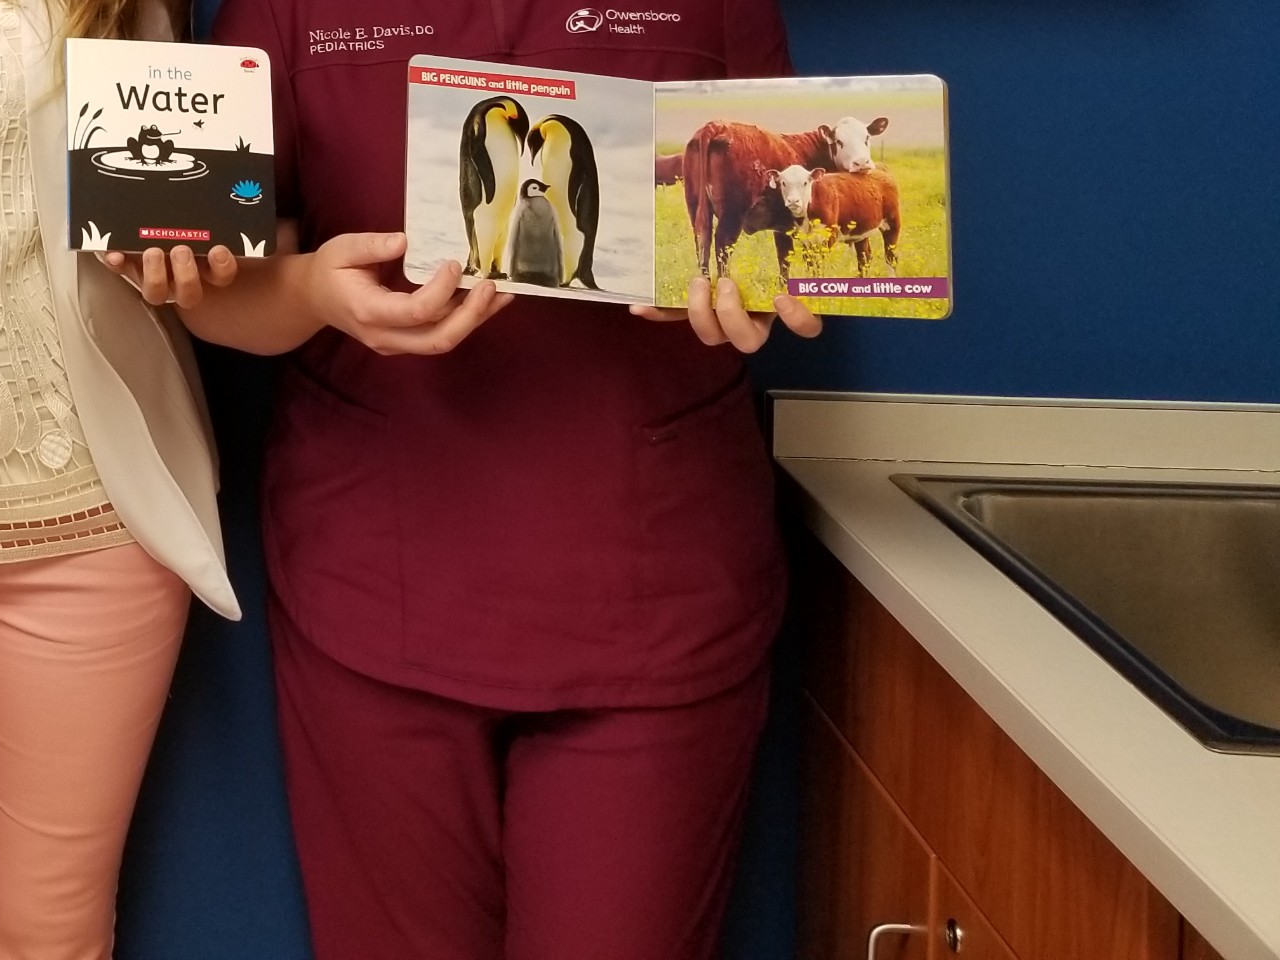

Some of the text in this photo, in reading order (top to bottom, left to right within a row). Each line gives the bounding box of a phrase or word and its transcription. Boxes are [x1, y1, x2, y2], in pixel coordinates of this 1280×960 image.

[605, 9, 681, 22] Owensboro
[308, 27, 351, 43] Nicole
[608, 23, 645, 35] Health
[309, 40, 385, 55] PEDIATRICS
[148, 65, 193, 81] in the
[421, 71, 571, 96] BIG PENGUINS and little penguin
[115, 82, 225, 115] Water
[149, 229, 209, 239] SCHOLASTIC
[798, 282, 932, 294] BIG COW and little cow
